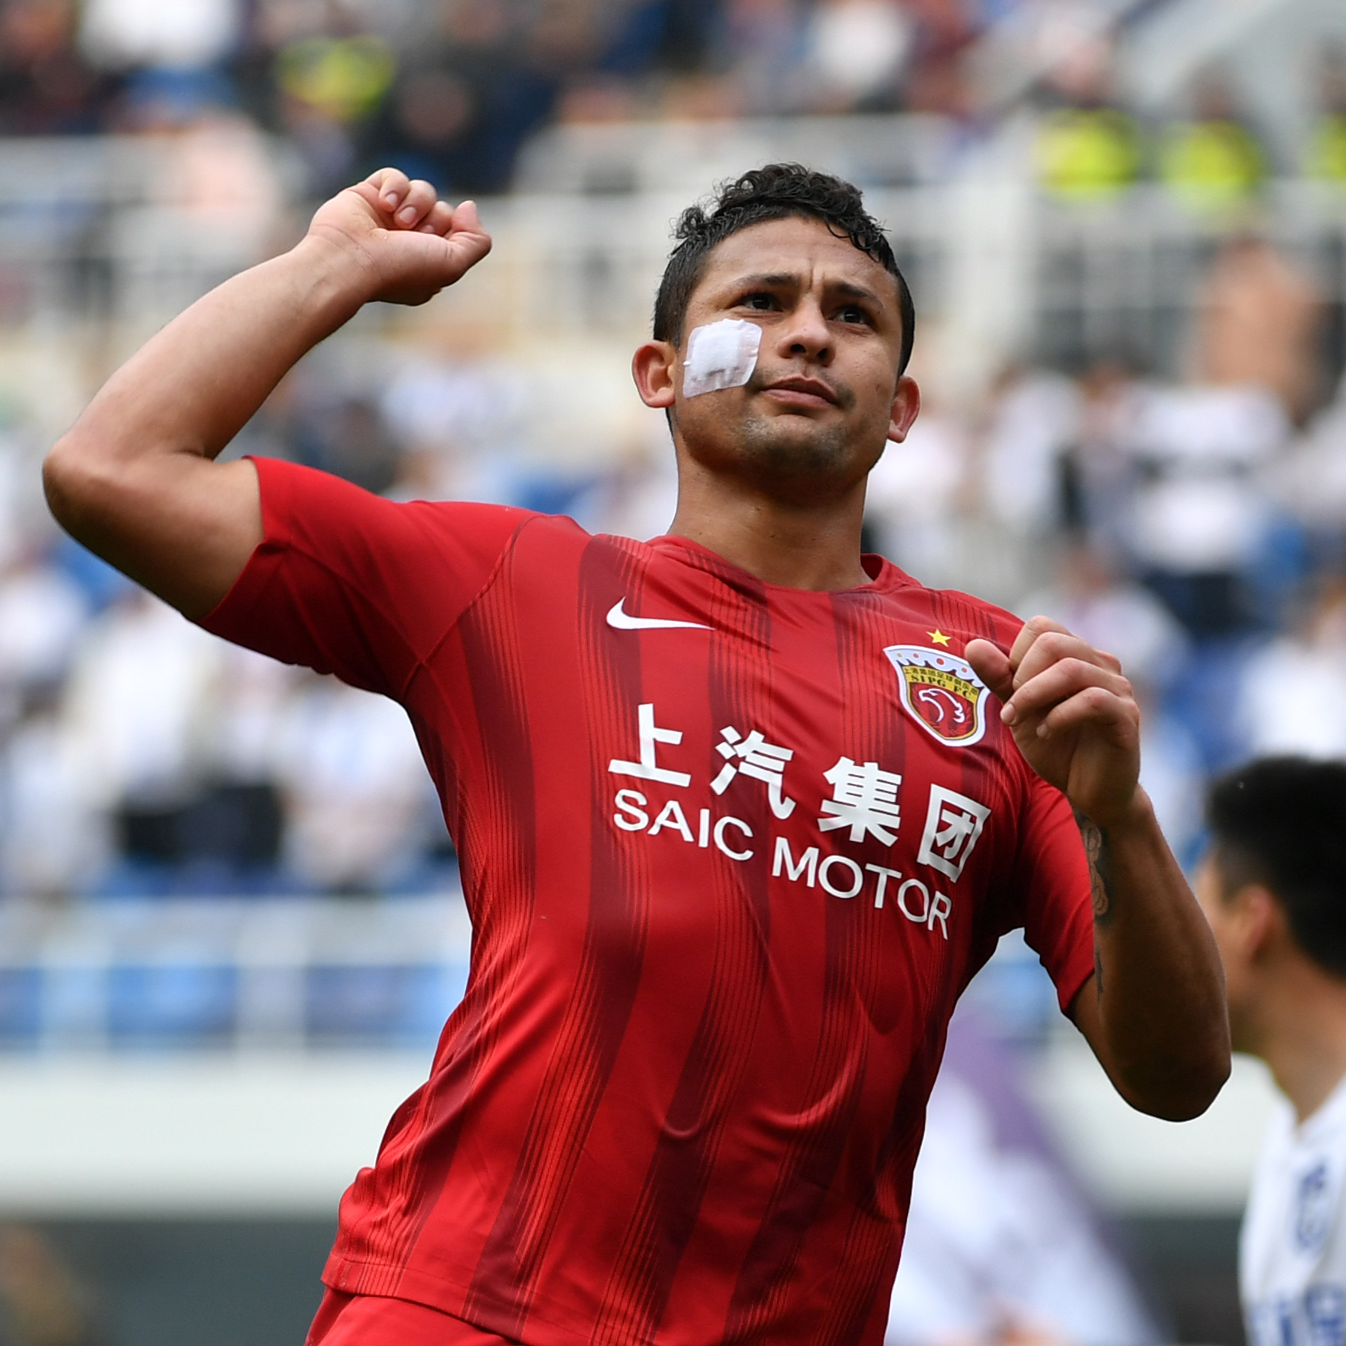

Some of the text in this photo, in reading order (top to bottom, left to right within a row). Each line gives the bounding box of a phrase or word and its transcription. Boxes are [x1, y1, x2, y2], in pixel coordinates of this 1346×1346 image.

[911, 674, 946, 688] SIPG
[608, 702, 992, 884] 上汽集团
[613, 788, 953, 940] SAIC MOTOR
